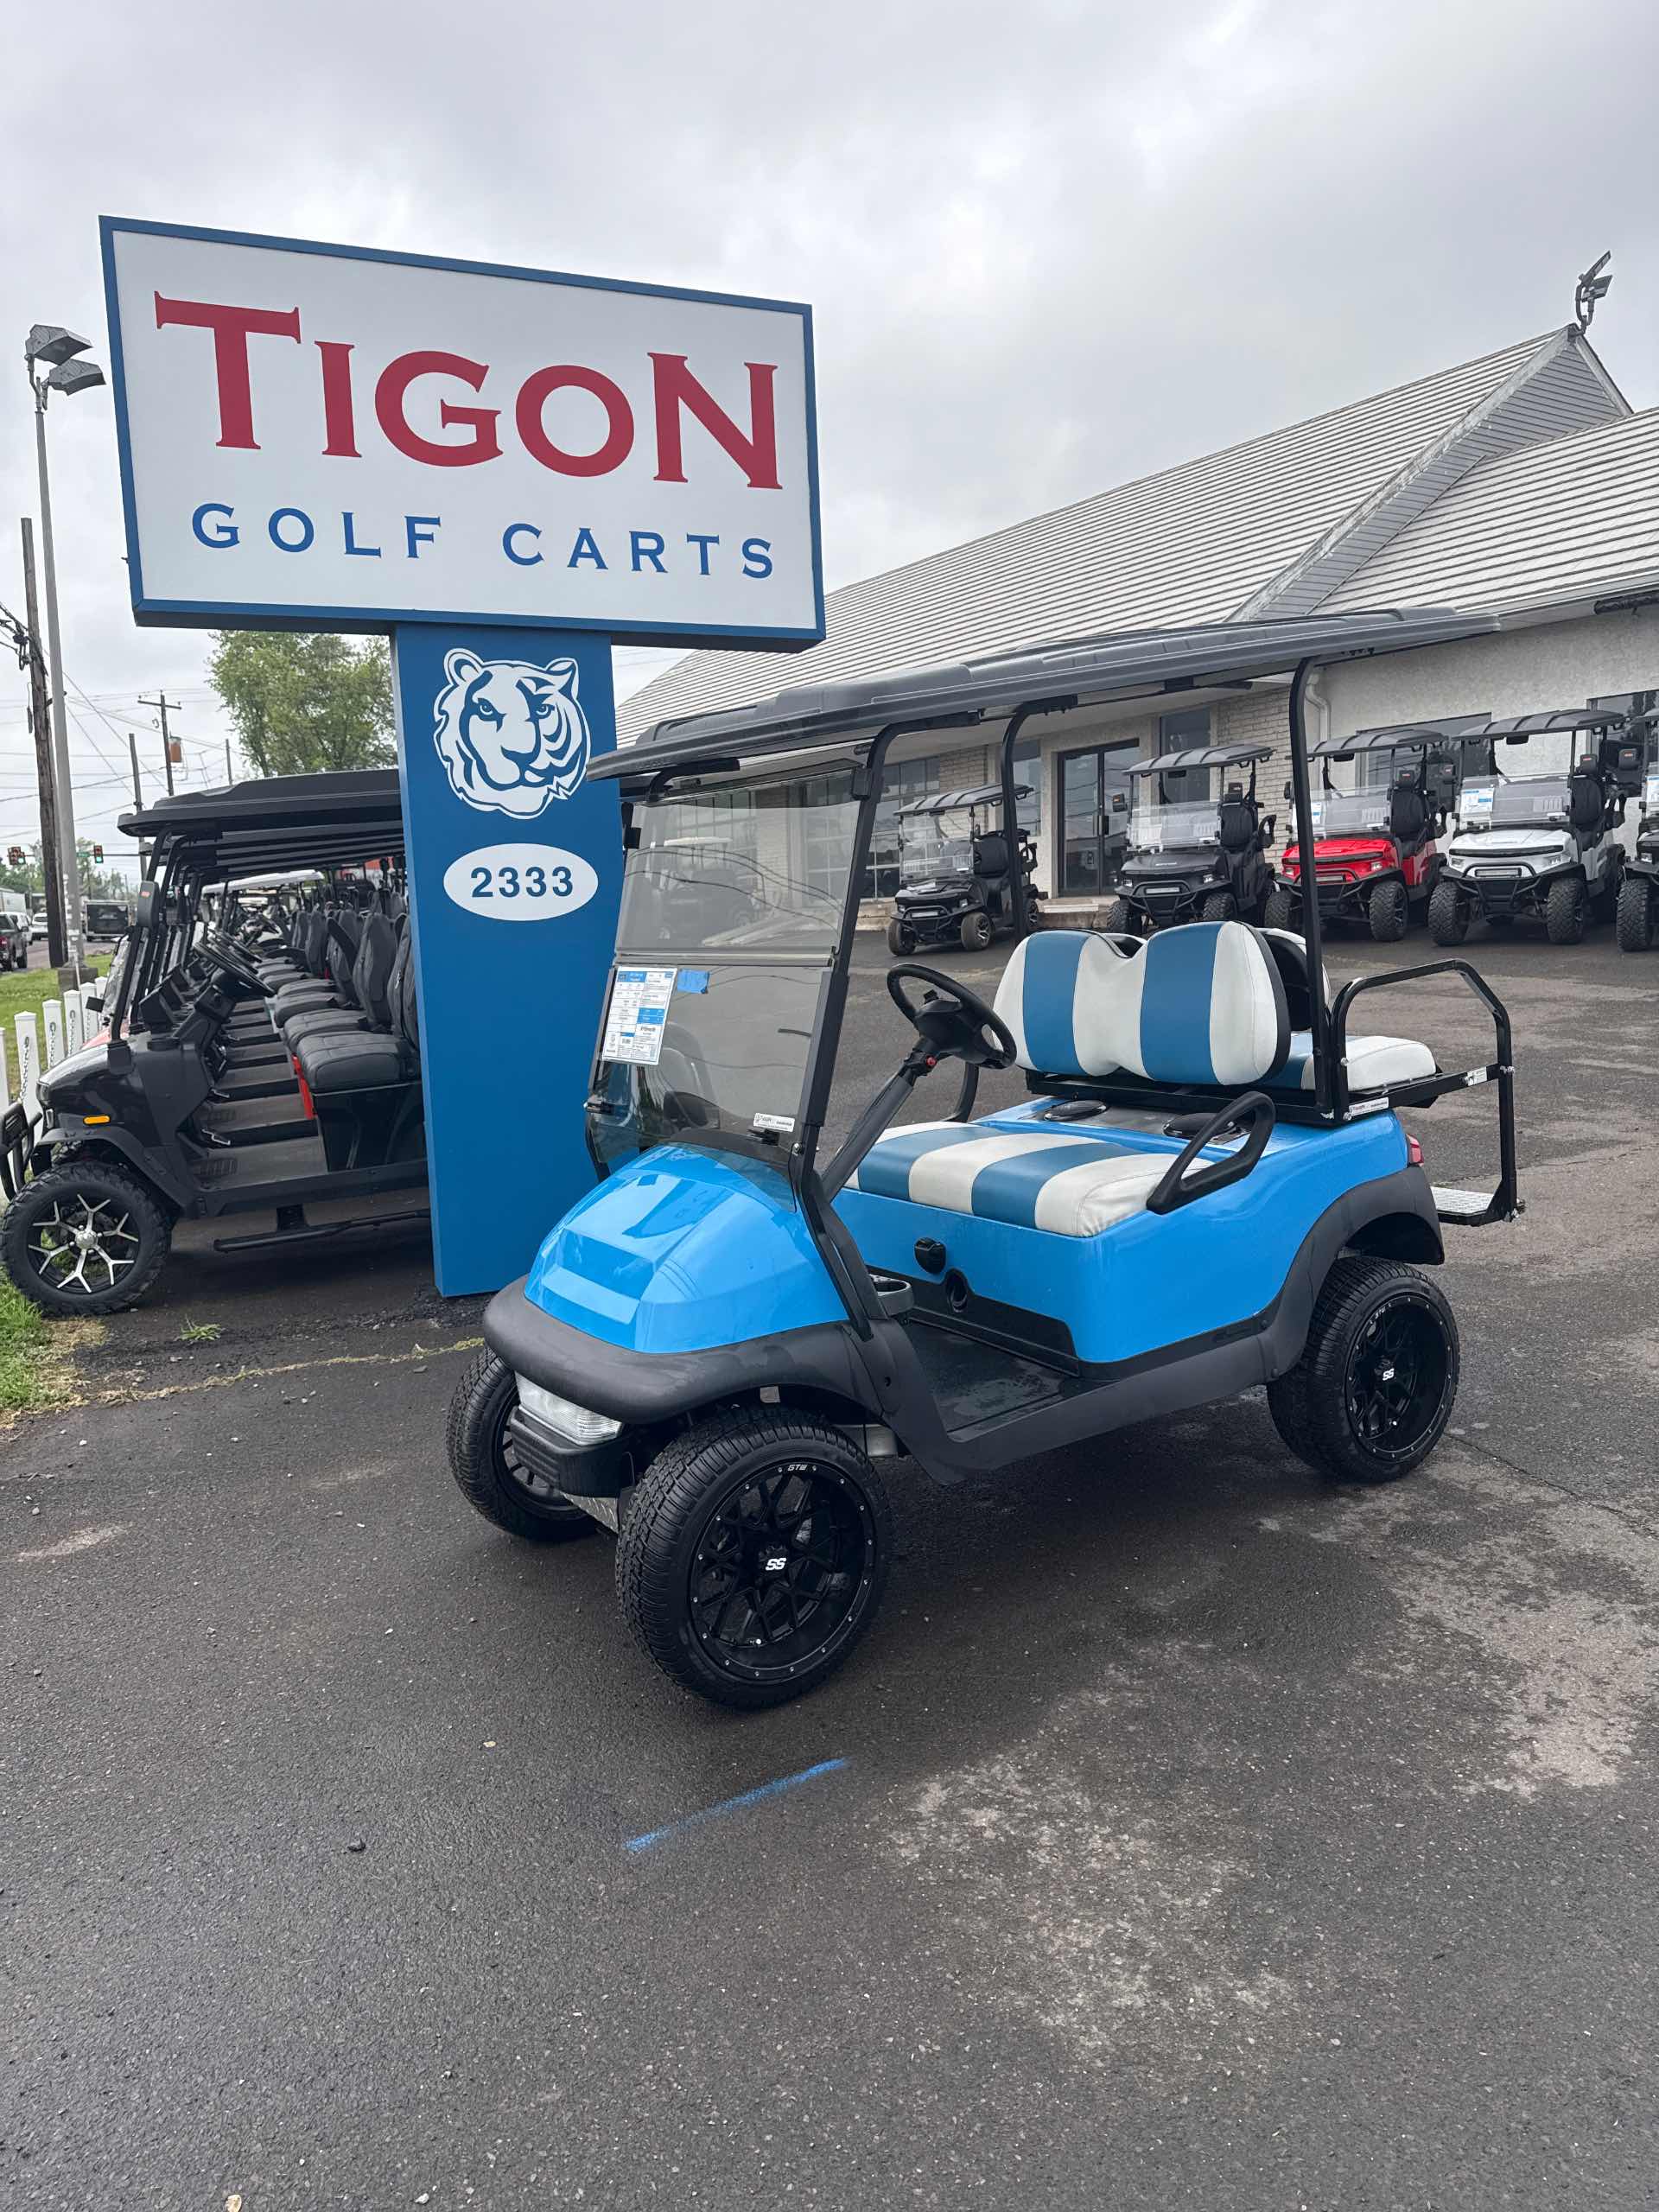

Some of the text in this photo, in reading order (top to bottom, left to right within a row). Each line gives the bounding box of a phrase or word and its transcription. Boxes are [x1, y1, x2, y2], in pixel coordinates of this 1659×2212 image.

[154, 290, 782, 490] TIGON
[192, 502, 773, 579] GOLF CARTS
[470, 866, 574, 899] 2333
